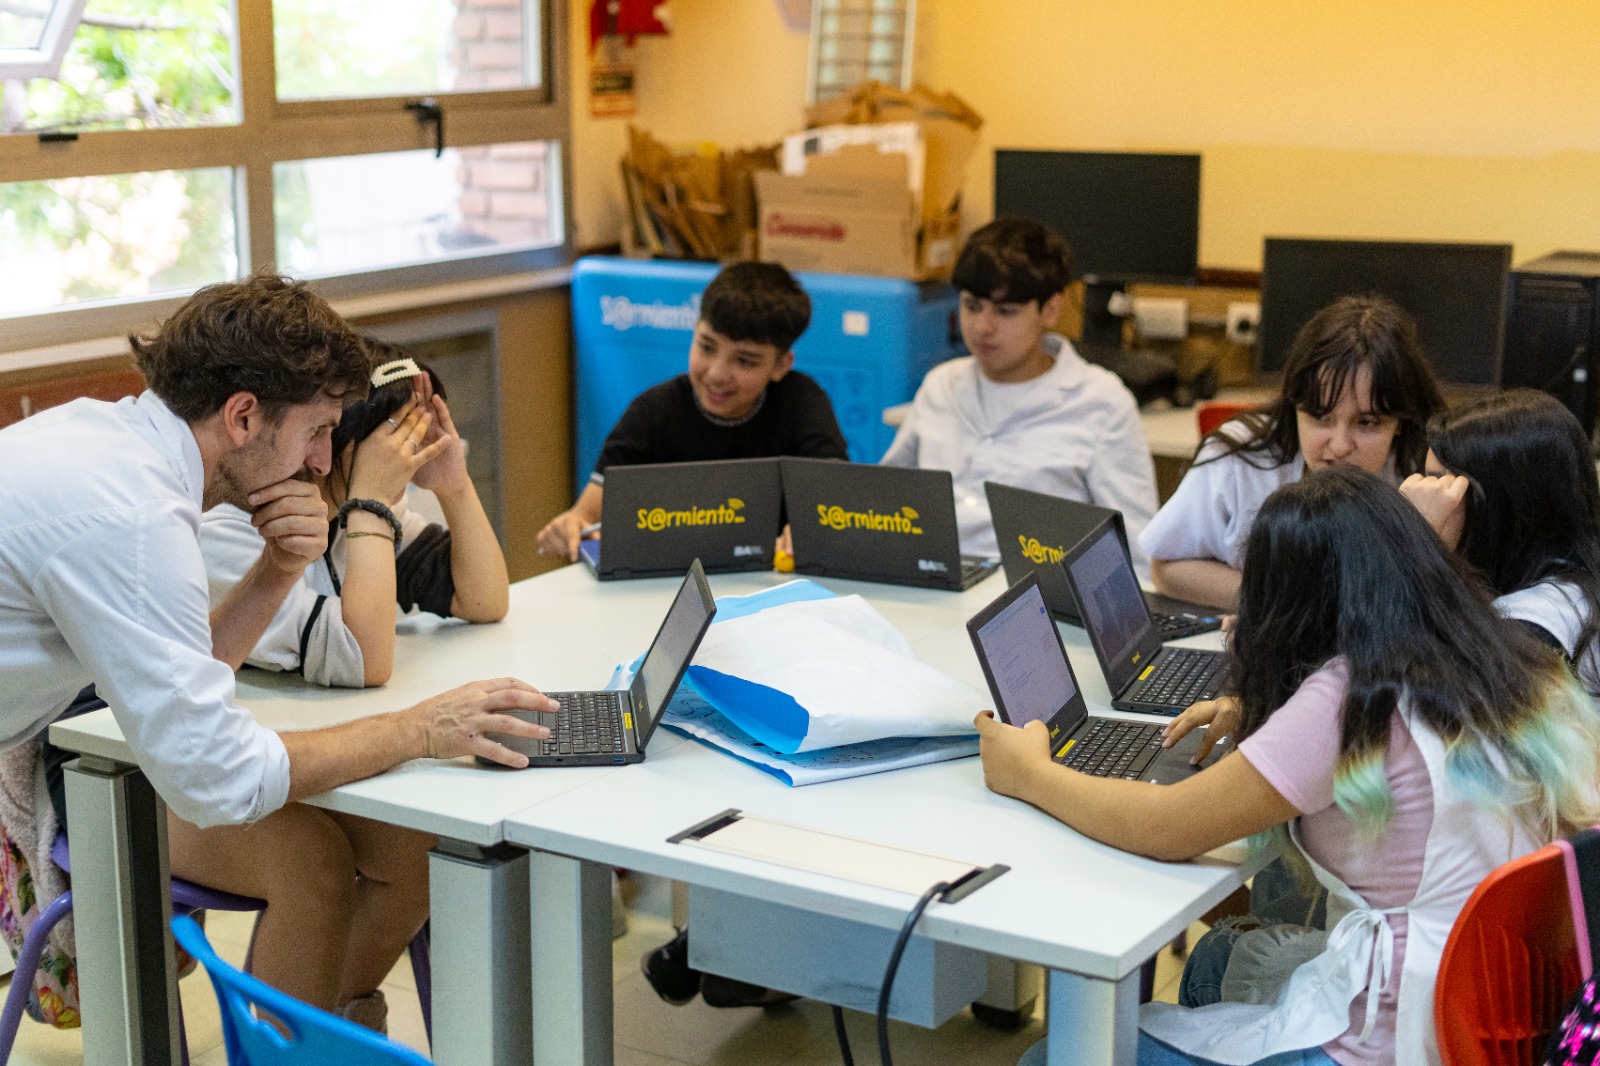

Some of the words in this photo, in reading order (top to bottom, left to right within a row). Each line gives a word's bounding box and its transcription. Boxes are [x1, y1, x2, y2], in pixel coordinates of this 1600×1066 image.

[637, 504, 735, 531] S@rmiento
[817, 504, 912, 534] S@rmiento
[1018, 534, 1065, 564] S@rmi
